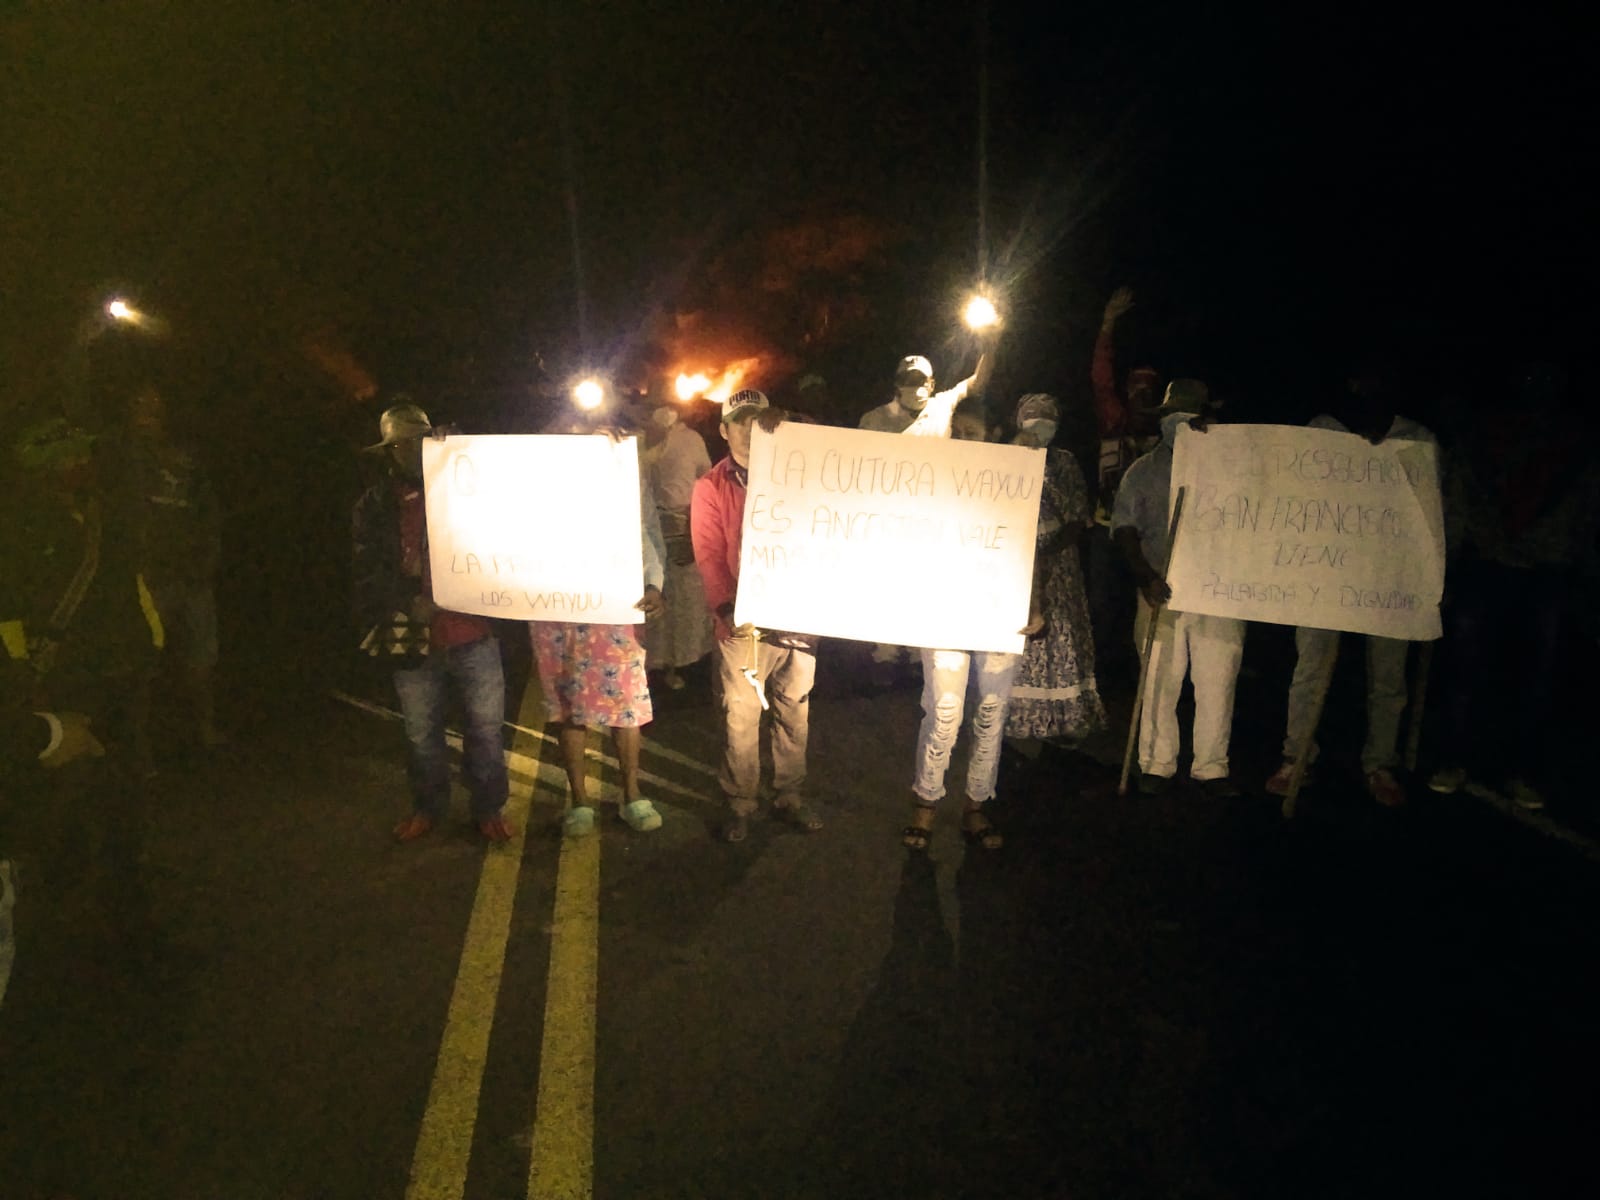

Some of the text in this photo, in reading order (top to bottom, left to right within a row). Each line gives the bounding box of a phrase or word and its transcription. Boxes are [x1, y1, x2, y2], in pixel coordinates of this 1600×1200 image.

[769, 444, 1036, 502] LA CULTURA WAYUU
[750, 494, 792, 535] ES
[523, 591, 604, 613] WAYUU
[1309, 585, 1321, 604] Y
